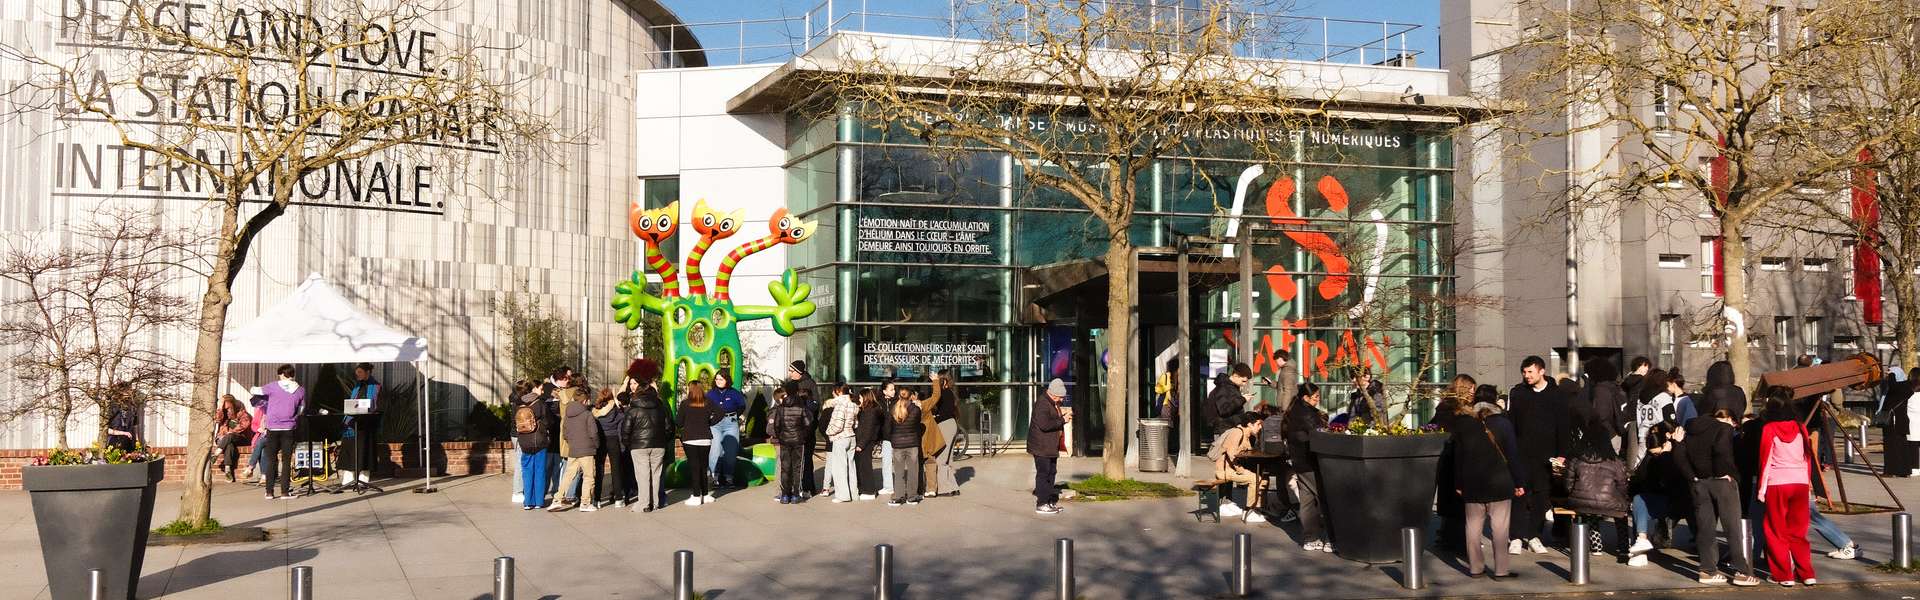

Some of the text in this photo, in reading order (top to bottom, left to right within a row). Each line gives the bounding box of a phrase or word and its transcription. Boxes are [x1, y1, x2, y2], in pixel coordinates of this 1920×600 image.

[61, 0, 448, 76] PEACE AND LOVE.
[58, 69, 499, 147] LA STATION SPATIALE
[1289, 130, 1306, 143] ET
[56, 142, 443, 208] INTERNATONALE.
[859, 217, 990, 231] L'ÉMOTION NAÎT DE L'ACCUMULATION
[859, 228, 894, 239] D'HÉLIUM
[895, 231, 915, 240] DANS
[917, 231, 925, 240] LE
[955, 231, 976, 242] L'ÂME
[859, 241, 992, 254] DEMEURE AINSI TOUJOURS EN ORBITE.
[863, 343, 987, 354] LES COLLECTIONNEURS D'ART SONT
[1223, 319, 1392, 380] AFRAN
[863, 354, 878, 364] DES
[879, 354, 920, 365] CHASSEURS
[921, 355, 931, 365] DE
